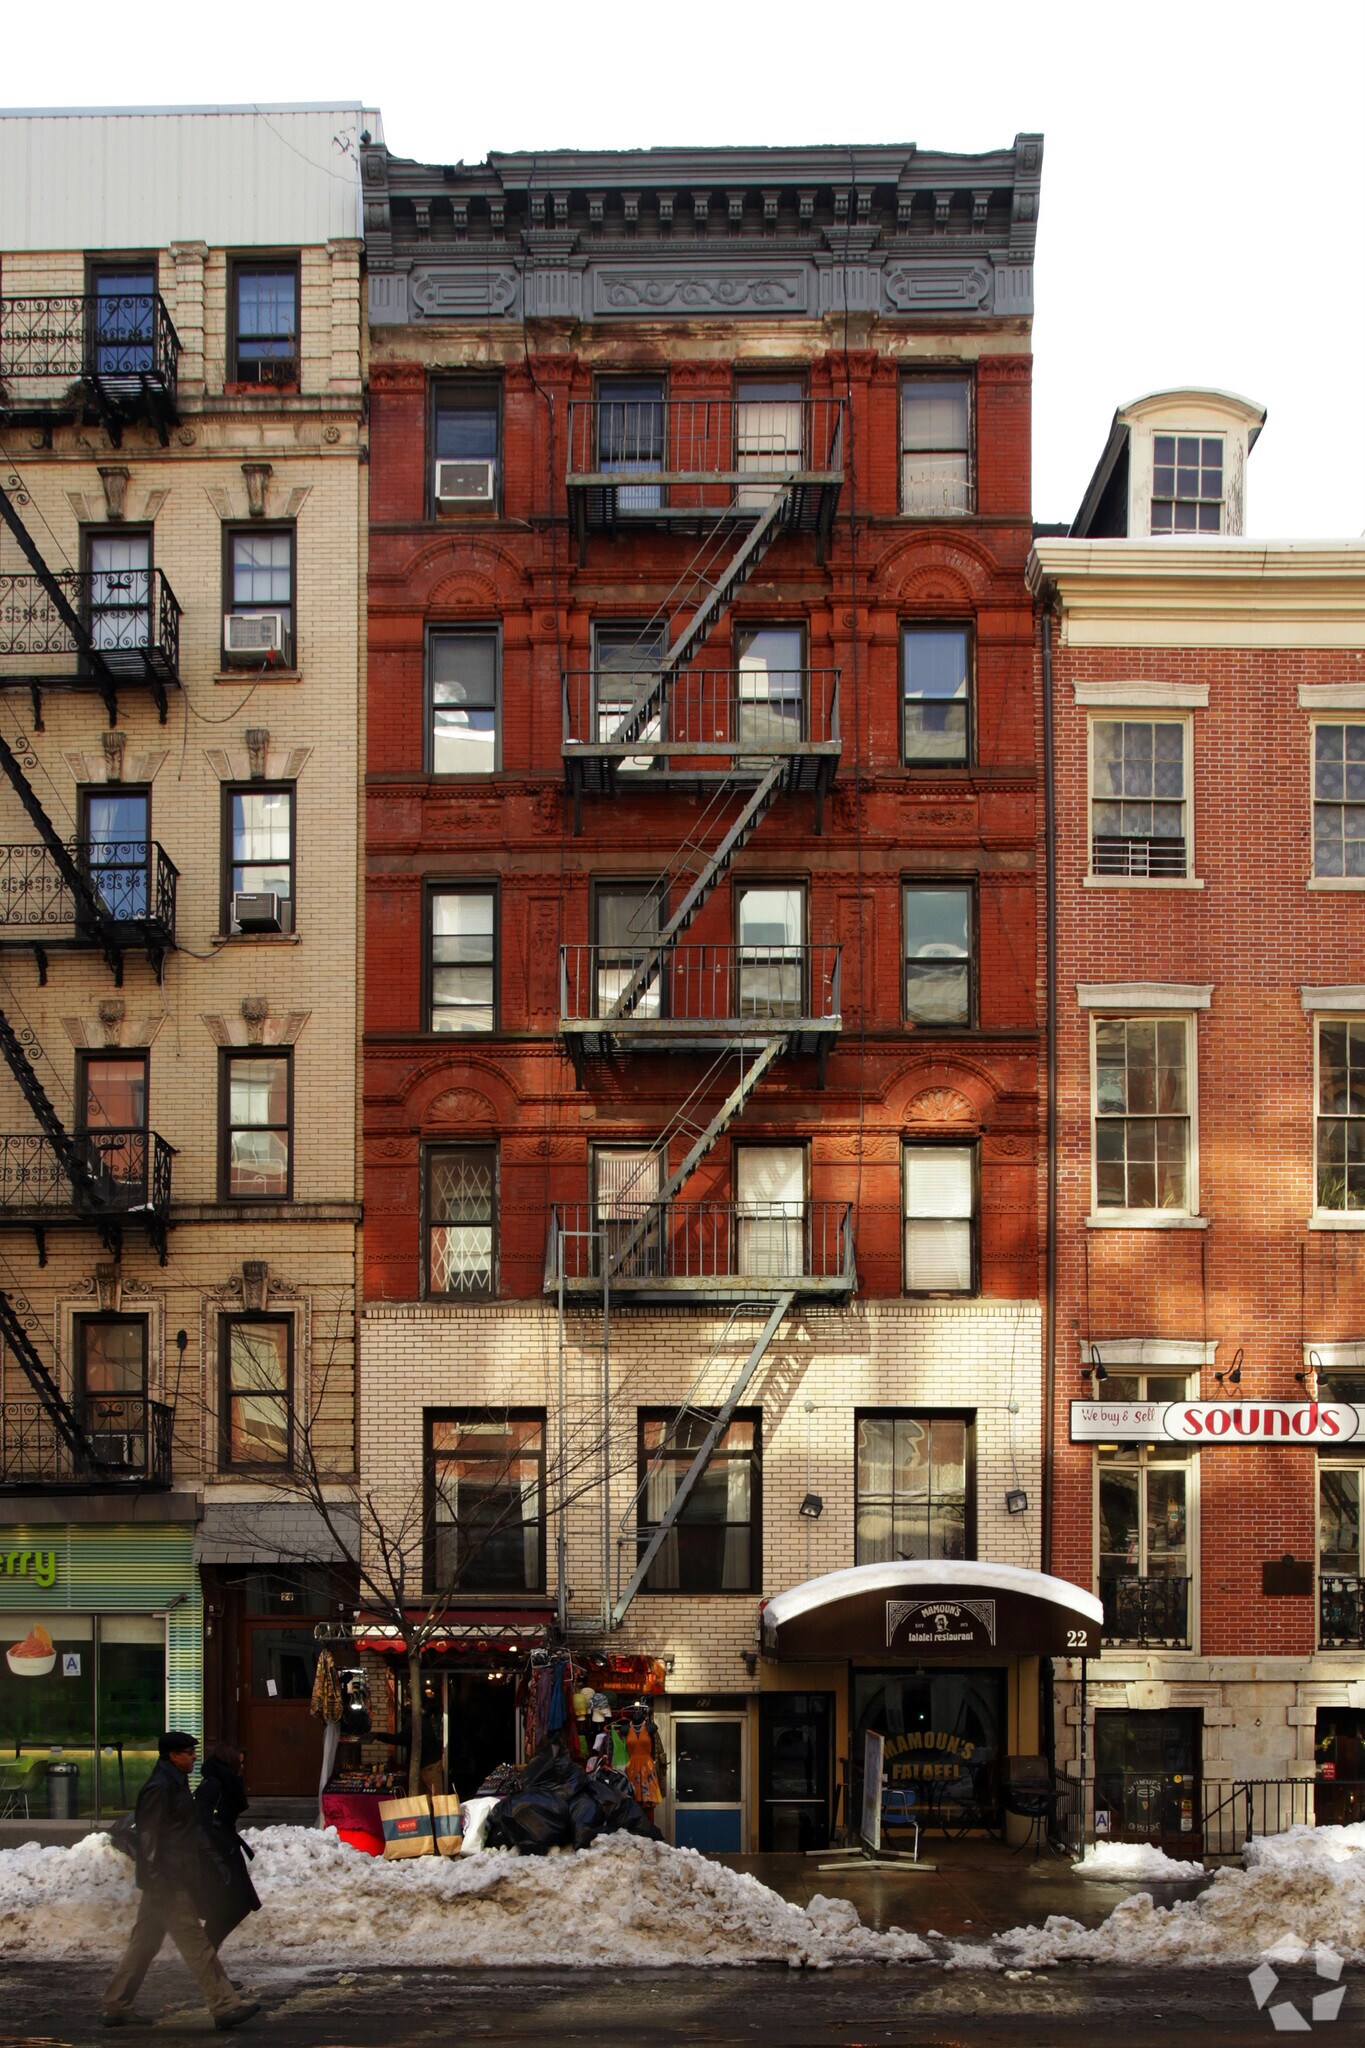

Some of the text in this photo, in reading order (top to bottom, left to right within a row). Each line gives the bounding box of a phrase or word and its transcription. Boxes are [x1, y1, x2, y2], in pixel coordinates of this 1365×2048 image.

[1081, 1408, 1097, 1421] We
[1100, 1407, 1120, 1427] buy
[0, 1551, 55, 1587] rry
[934, 1631, 974, 1642] restaurant
[1066, 1630, 1088, 1647] 22
[66, 1656, 78, 1671] A
[884, 1730, 975, 1760] MAMOUN'S
[892, 1763, 961, 1781] FALAFEL
[1095, 1813, 1108, 1827] A
